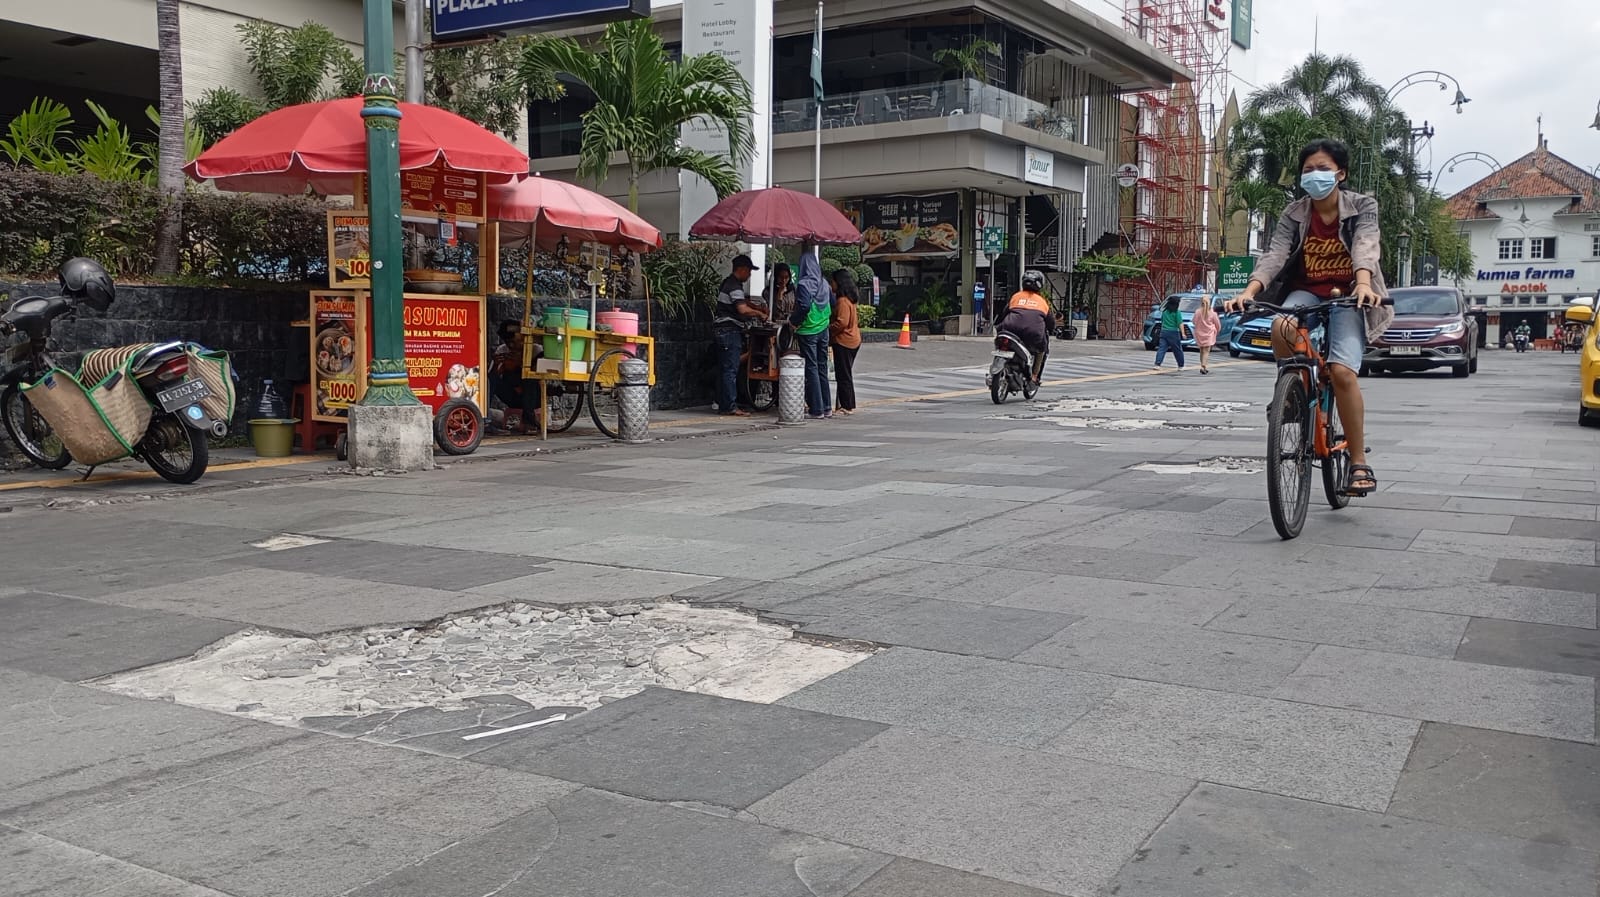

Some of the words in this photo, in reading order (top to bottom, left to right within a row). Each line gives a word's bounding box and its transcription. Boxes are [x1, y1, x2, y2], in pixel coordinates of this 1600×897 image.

[701, 20, 718, 28] Hotel
[1477, 269, 1520, 281] kimia
[1525, 267, 1575, 280] farma
[1501, 282, 1548, 295] Apotek
[425, 357, 442, 367] DARI
[329, 381, 356, 401] 1000
